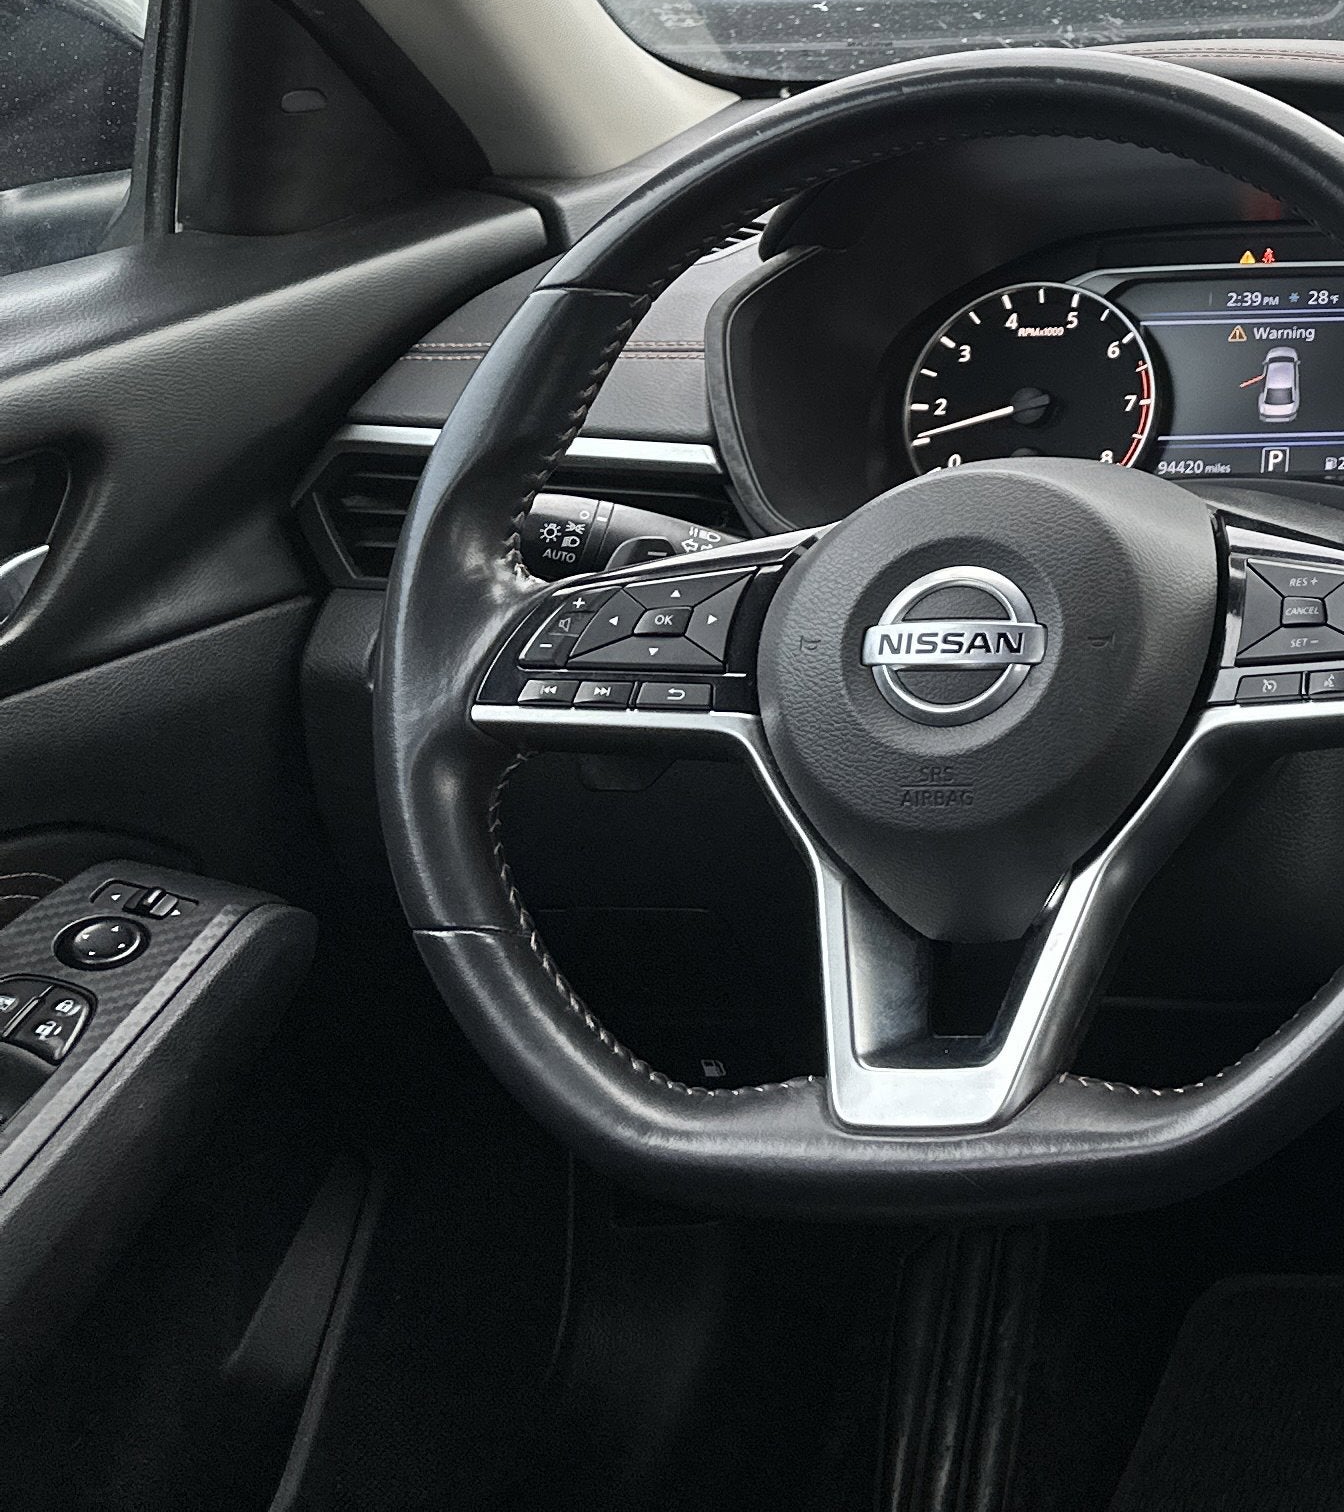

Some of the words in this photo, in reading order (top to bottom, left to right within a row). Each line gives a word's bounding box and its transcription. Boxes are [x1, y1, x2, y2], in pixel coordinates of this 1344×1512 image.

[1226, 292, 1262, 308] 2:39
[1004, 312, 1019, 330] 4
[1066, 311, 1079, 328] 5
[1253, 326, 1316, 342] Warning
[957, 344, 971, 363] 3
[1107, 341, 1120, 358] 6
[933, 398, 948, 416] 2
[1124, 395, 1138, 412] 7
[1100, 450, 1113, 464] 8
[1268, 451, 1283, 471] P
[1157, 460, 1204, 475] 94420
[1205, 463, 1231, 474] miles
[542, 548, 577, 564] AUTO
[1289, 577, 1308, 587] RES
[1285, 606, 1320, 617] CANCEL
[654, 614, 674, 626] OK
[877, 631, 1026, 656] NISSAN
[1290, 638, 1309, 648] SET
[901, 789, 975, 807] AIRBAG
